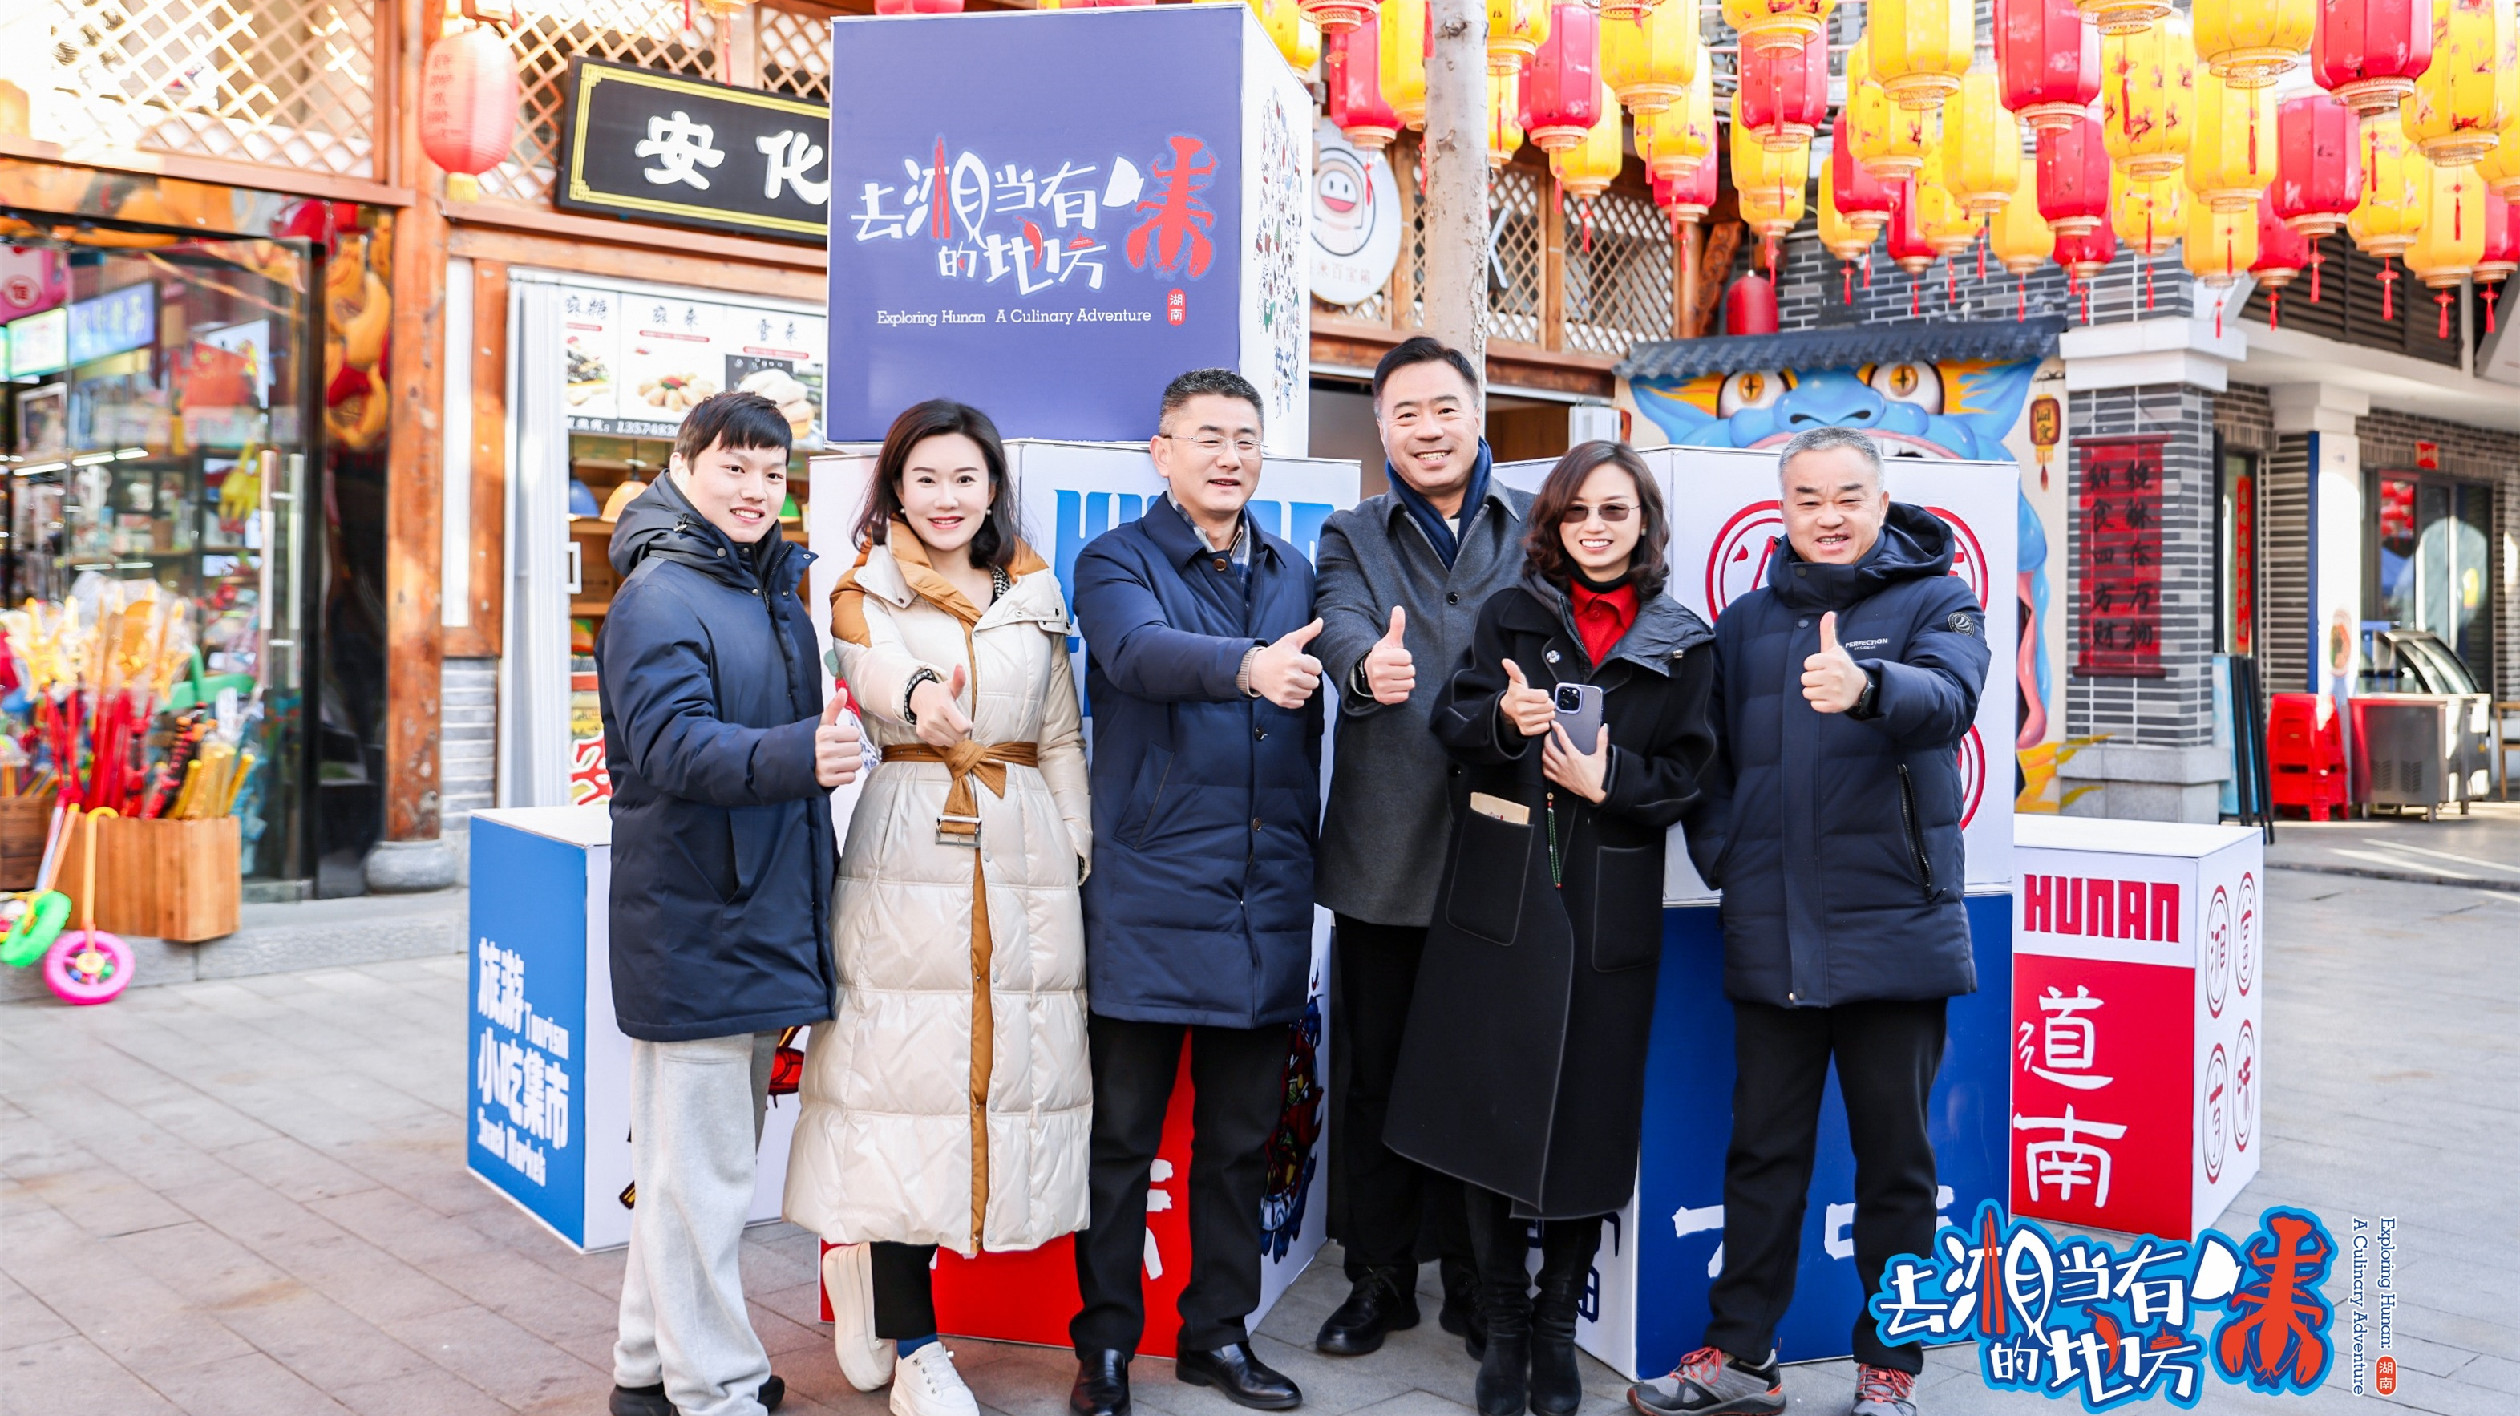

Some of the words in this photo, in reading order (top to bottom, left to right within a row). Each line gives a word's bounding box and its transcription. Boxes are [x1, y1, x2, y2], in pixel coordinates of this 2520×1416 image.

[635, 111, 829, 205] 安化
[939, 220, 1107, 295] 的地方
[876, 310, 937, 326] Exploring
[941, 310, 986, 324] Hunan
[995, 309, 1007, 323] A
[1010, 309, 1075, 325] Culinary
[1077, 308, 1152, 323] Adventure
[1169, 293, 1184, 322] 湖南
[2024, 874, 2179, 943] HUNAN
[478, 937, 525, 1034] 旅游
[478, 1026, 569, 1150] 小吃集市
[2013, 985, 2128, 1208] 道南
